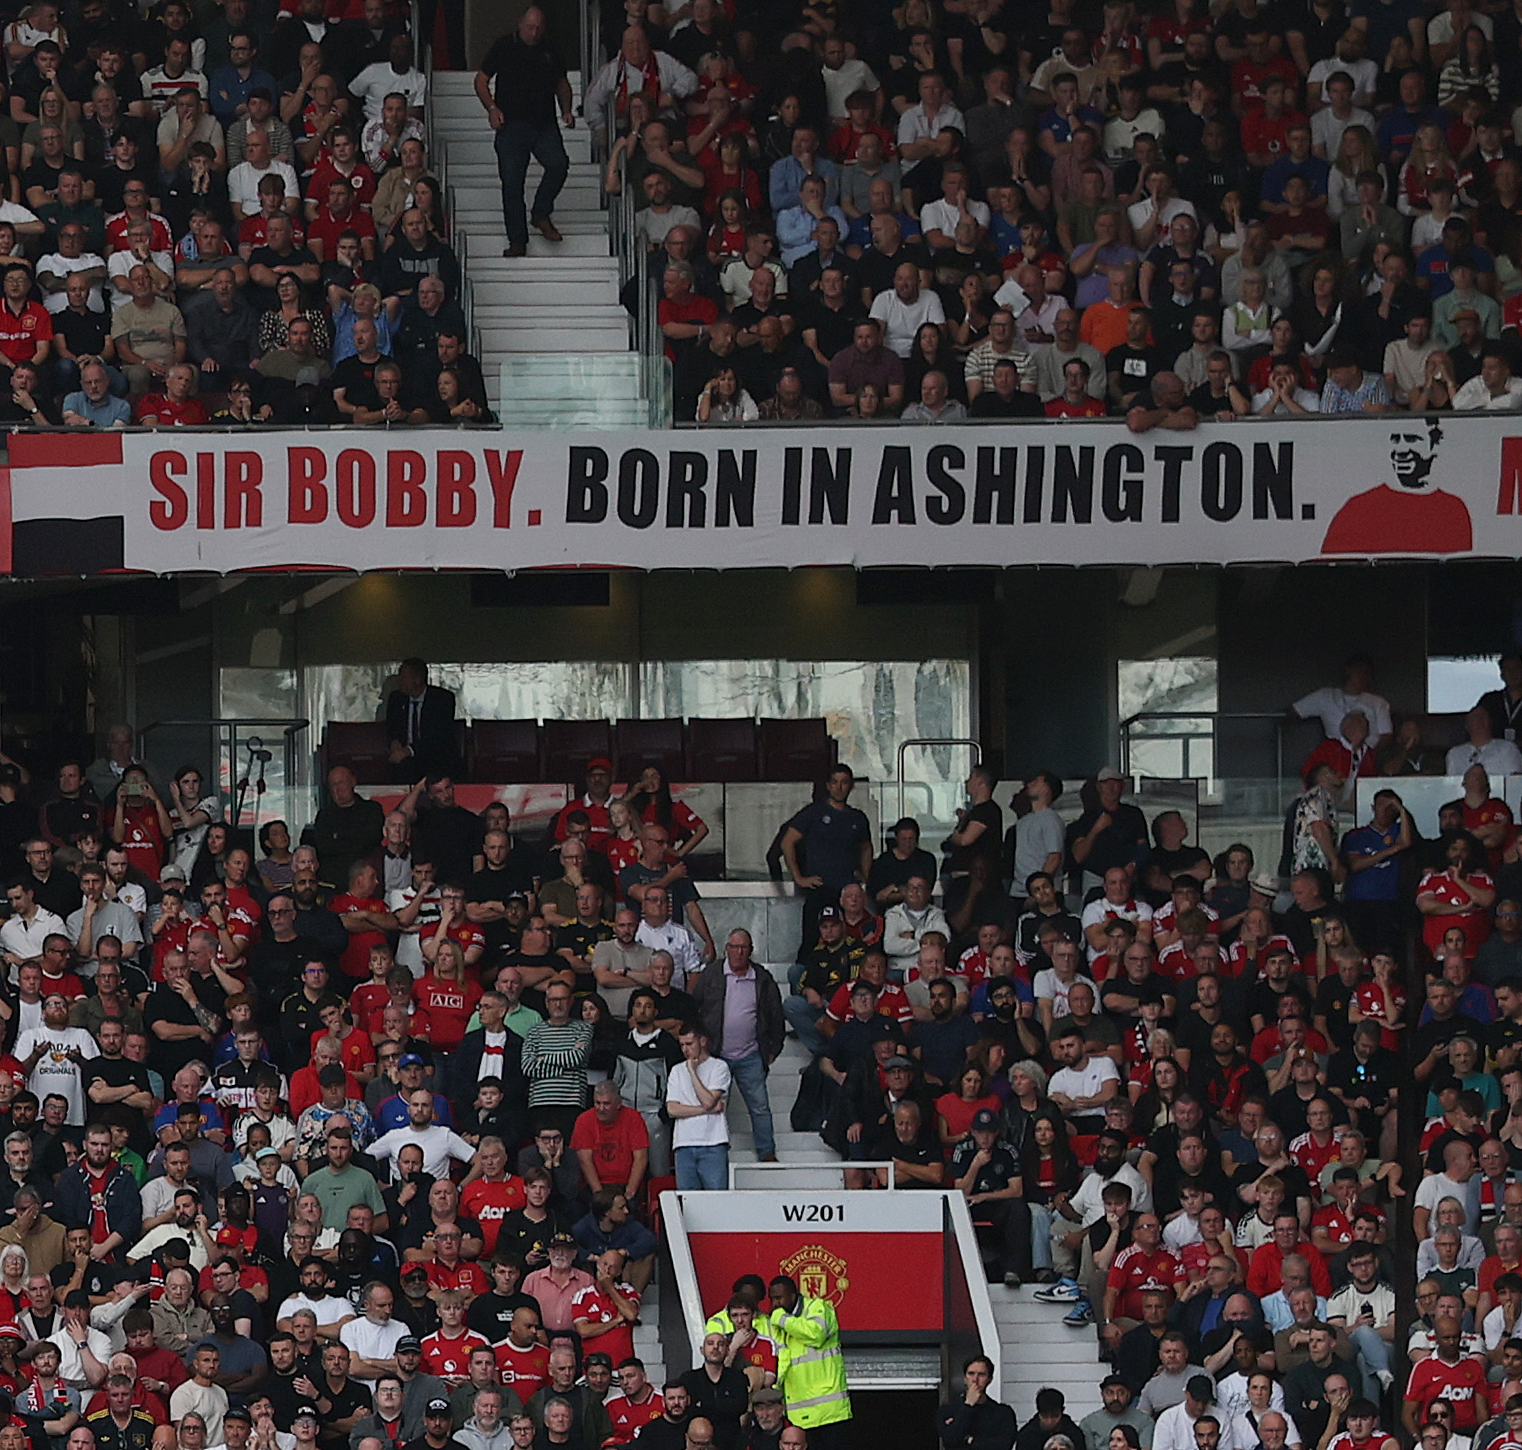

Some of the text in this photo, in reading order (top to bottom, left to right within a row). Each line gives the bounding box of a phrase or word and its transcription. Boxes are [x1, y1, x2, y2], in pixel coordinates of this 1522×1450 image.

[150, 440, 1316, 531] SIR BOBBY. BORN IN ASHINGTON.
[432, 994, 463, 1007] AIG
[782, 1204, 845, 1223] W201
[784, 1250, 842, 1276] MANCHESTER
[1439, 1385, 1473, 1401] AON
